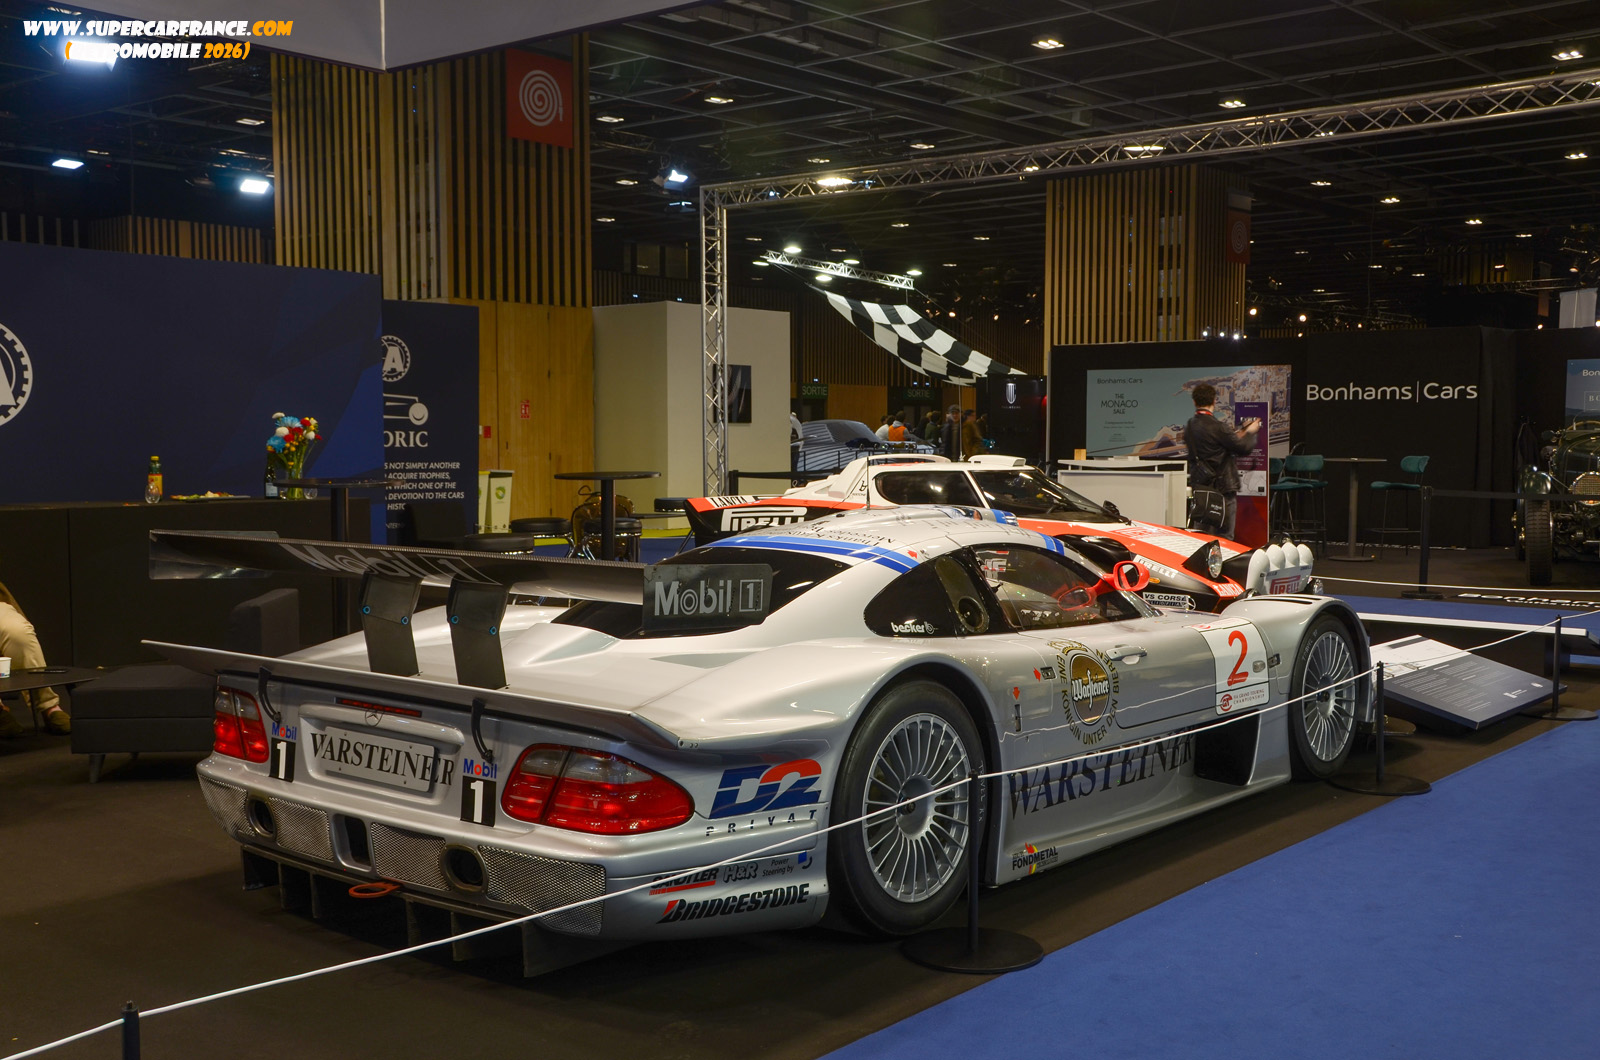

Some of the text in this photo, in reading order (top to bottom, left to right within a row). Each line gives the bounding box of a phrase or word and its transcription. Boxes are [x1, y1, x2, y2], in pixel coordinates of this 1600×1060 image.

[802, 385, 828, 396] SORTIE
[907, 388, 930, 398] SORTIE
[1306, 382, 1478, 401] Bonhams Cars
[1100, 399, 1139, 408] MONACO
[388, 472, 417, 480] ACQUIRE
[419, 472, 451, 480] TROPHIES,
[389, 462, 405, 470] NOT
[405, 462, 429, 470] SIMPLY
[429, 462, 460, 470] ANOTHER
[388, 492, 424, 500] DEVOTION
[448, 491, 465, 499] CARS
[418, 482, 433, 490] ONE
[710, 496, 748, 508] LANCIA
[720, 507, 808, 532] PIRELLI
[1212, 583, 1244, 597] LANCIA
[1269, 575, 1301, 595] PIRELLI
[654, 579, 754, 616] Mobil 1
[890, 621, 926, 634] becker
[1227, 630, 1249, 686] 2
[1056, 655, 1067, 685] EINE
[1083, 724, 1108, 745] UNTER
[1096, 648, 1120, 694] BIEREN
[271, 722, 297, 741] Mobil
[276, 741, 287, 780] 1
[463, 758, 498, 779] Mobil
[1007, 727, 1197, 820] WARSTEINER
[708, 759, 822, 819] D2
[470, 780, 484, 824] 1
[705, 809, 817, 836] PRIVAT
[770, 857, 789, 867] Power
[1012, 846, 1059, 870] FONDMETAL
[722, 861, 758, 884] H&R
[762, 865, 783, 878] Steering
[783, 865, 795, 876] by
[655, 883, 810, 925] BRIDGESTONE
